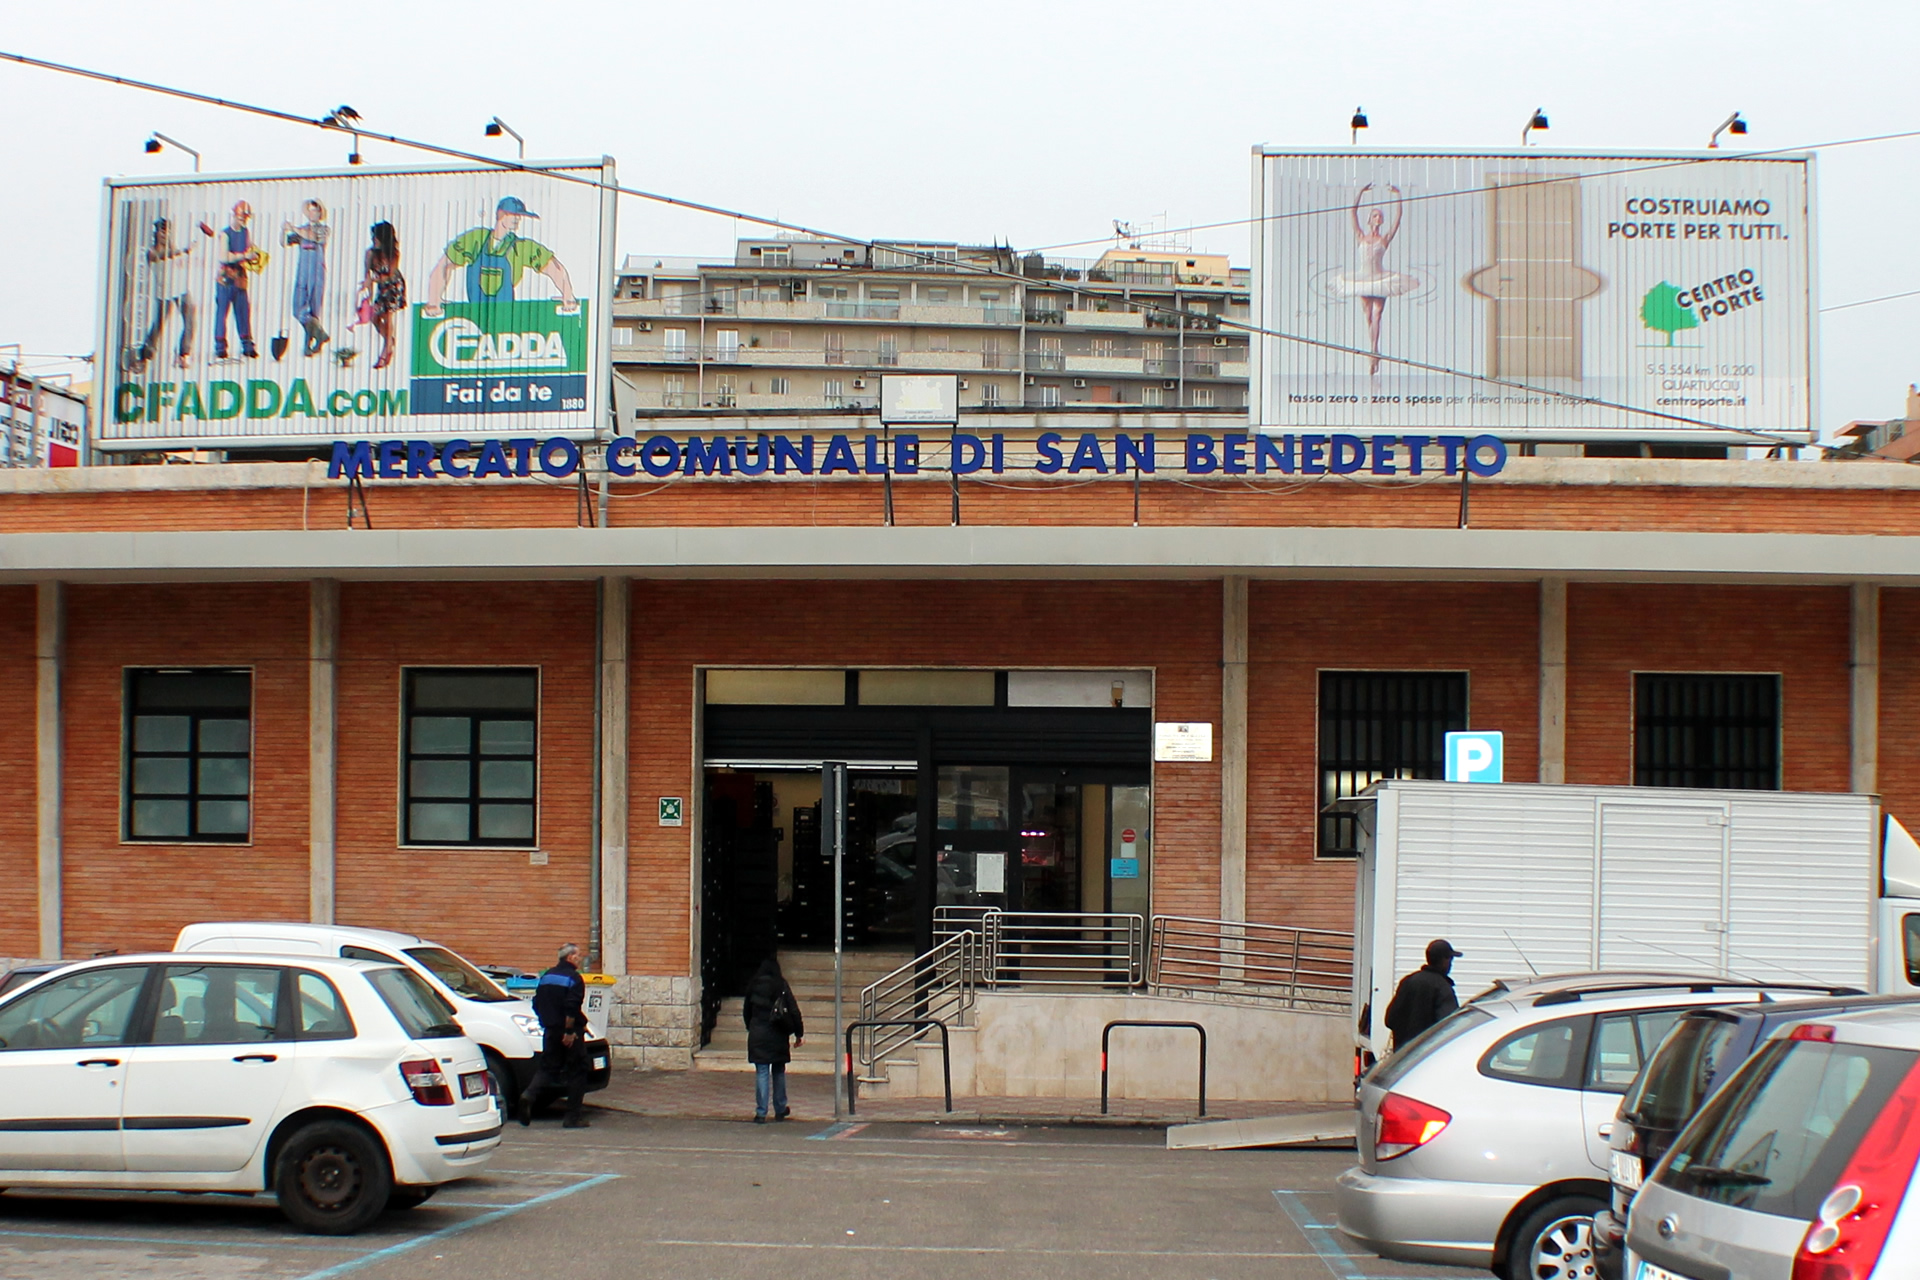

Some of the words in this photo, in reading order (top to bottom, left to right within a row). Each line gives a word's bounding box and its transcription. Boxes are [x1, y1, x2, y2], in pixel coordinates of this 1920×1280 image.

[1626, 198, 1770, 216] COSTRUIAMO
[1608, 223, 1676, 239] PORTE
[1684, 224, 1721, 240] PER
[1728, 224, 1789, 241] TUTTI.
[1677, 268, 1755, 308] CENTRO
[1700, 285, 1765, 322] PORTE
[1694, 363, 1711, 376] km
[1715, 364, 1755, 377] 10.200
[445, 381, 484, 404] Fai
[490, 380, 521, 403] da
[528, 383, 553, 402] te
[1662, 379, 1741, 392] QUARTUCCIU
[116, 378, 408, 424] CFADDA.COM
[1289, 393, 1325, 404] tasso
[1328, 394, 1359, 404] zero
[1362, 395, 1369, 404] e
[1371, 394, 1401, 404] zero
[1405, 394, 1443, 407] spese
[1446, 395, 1464, 407] per
[1467, 391, 1501, 404] rilievo
[1504, 393, 1540, 405] misure
[1543, 395, 1551, 405] e
[1553, 396, 1601, 409] traspo
[1656, 395, 1747, 409] centroporte.it
[328, 437, 579, 479] MERCATO
[606, 435, 919, 477] COMUNALE
[952, 434, 1004, 474] DI
[1035, 433, 1155, 475] SAN
[1187, 434, 1507, 477] BENEDETTO
[1457, 738, 1493, 782] P
